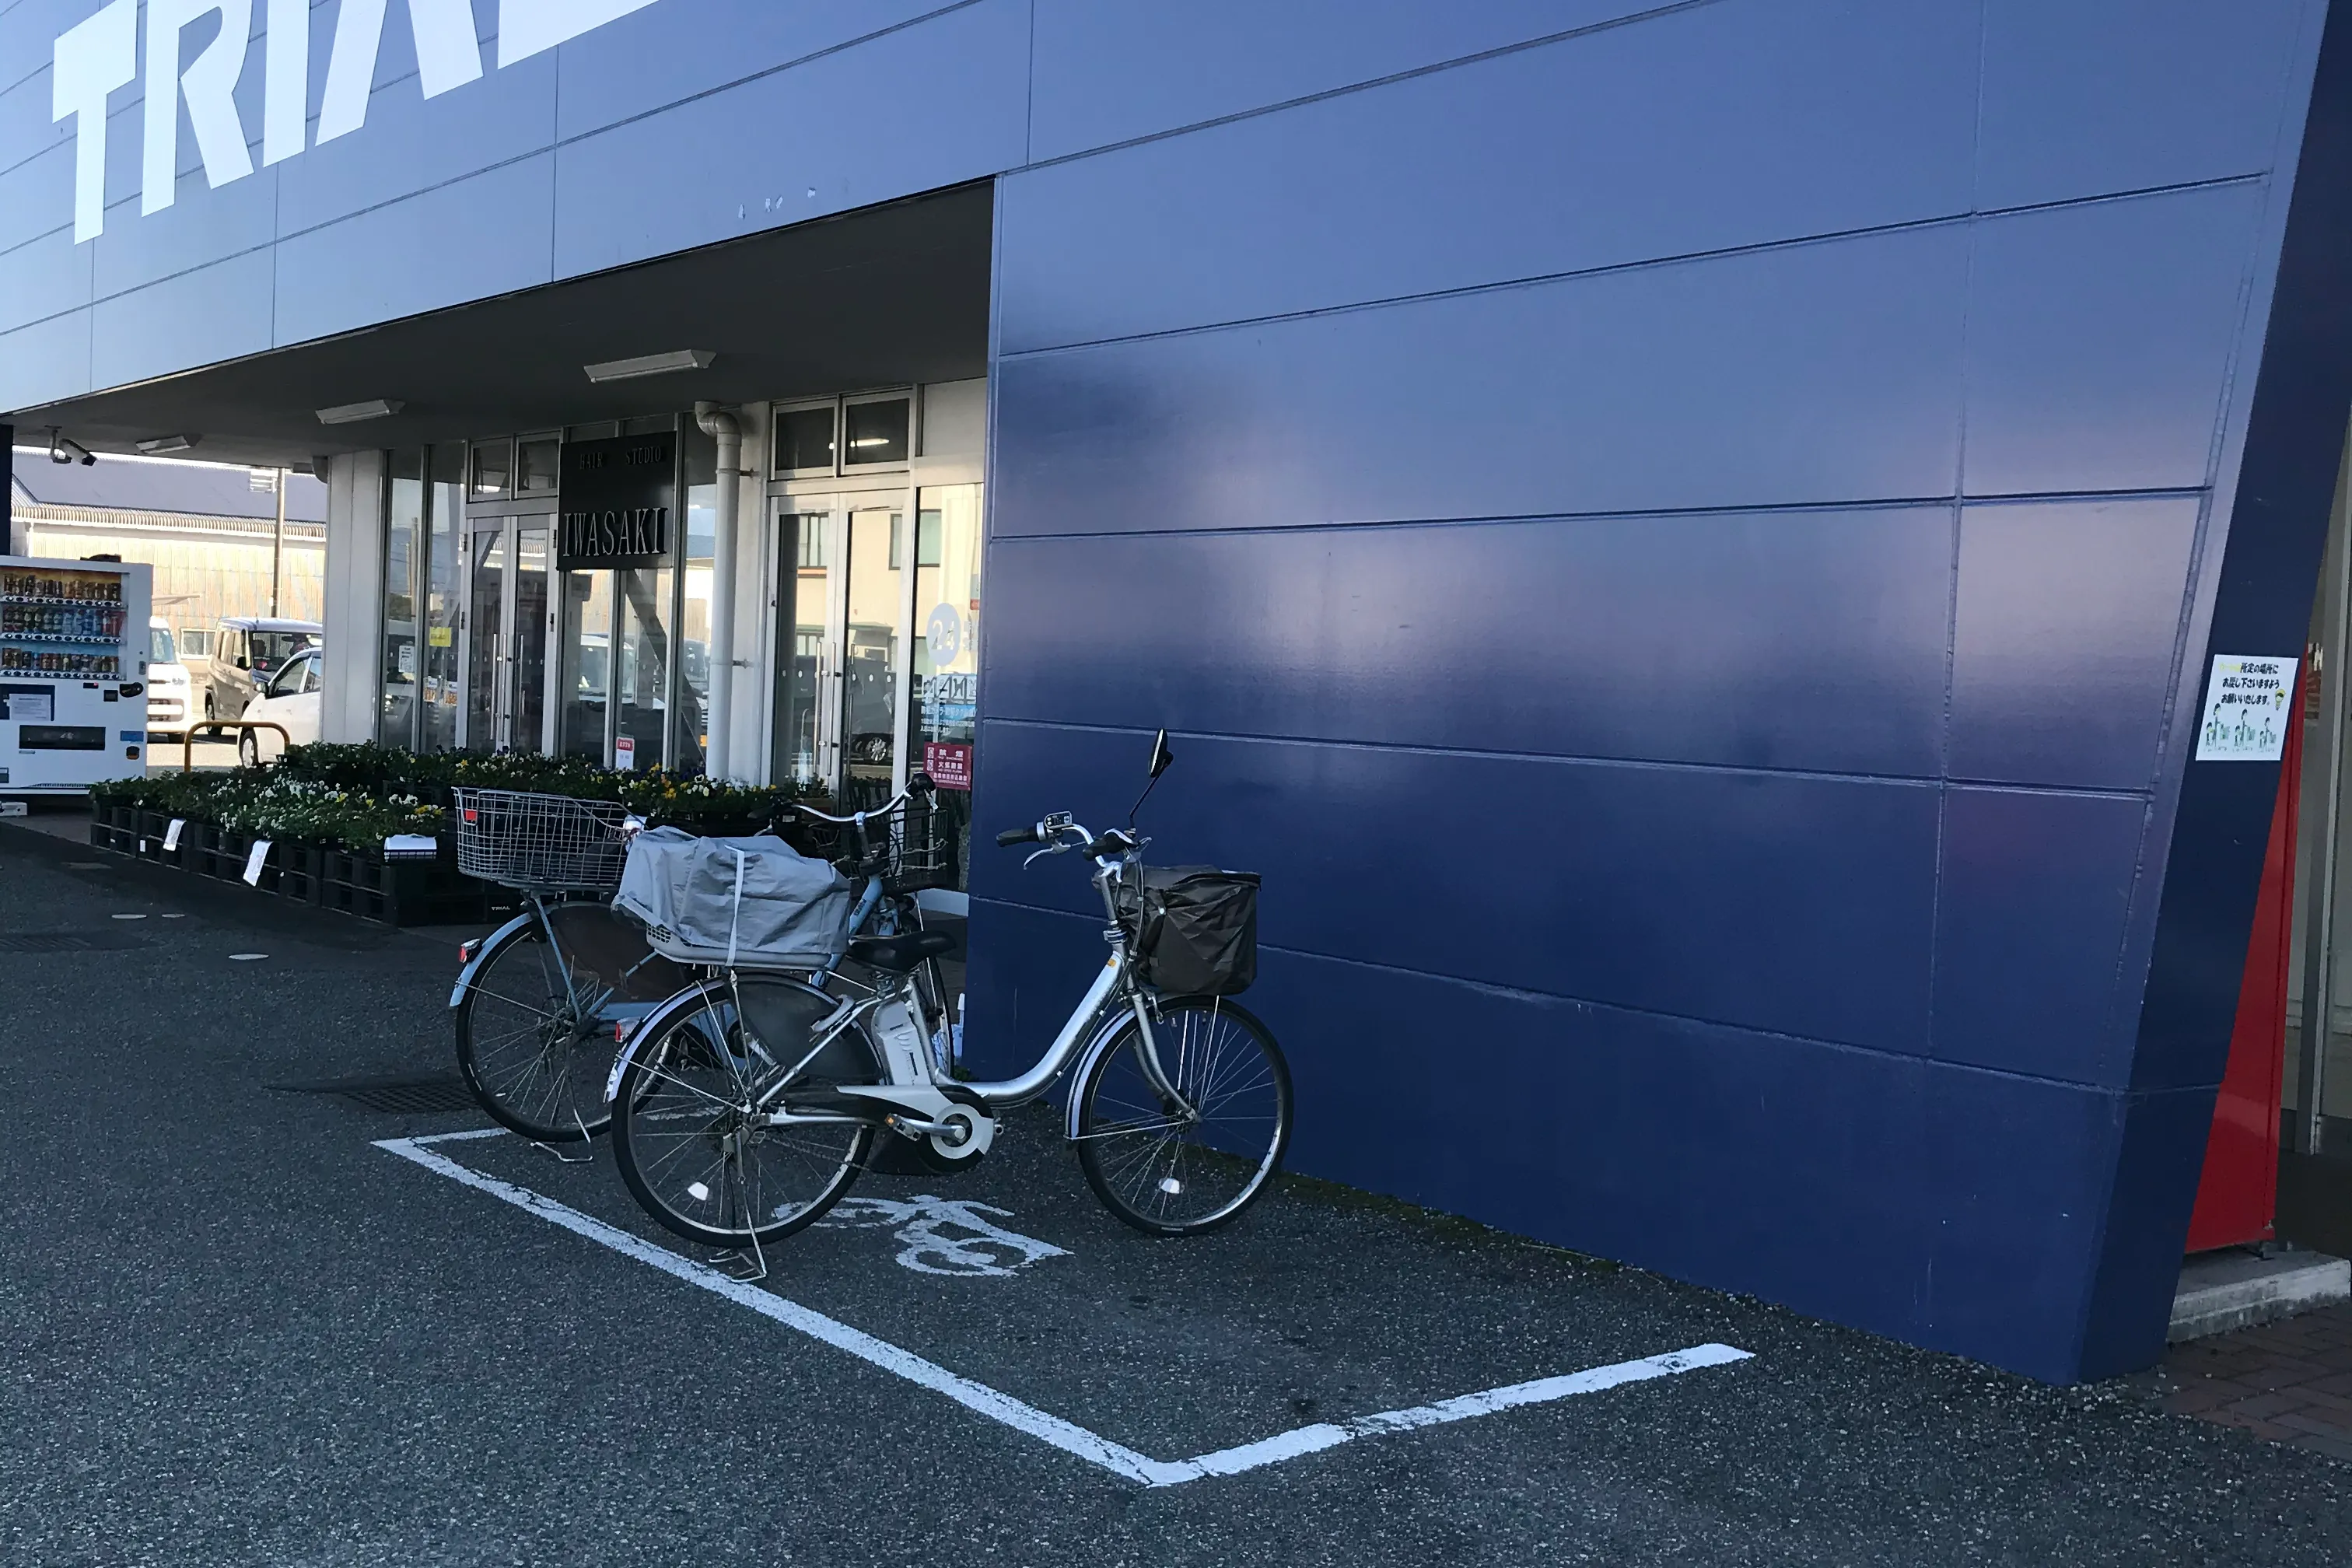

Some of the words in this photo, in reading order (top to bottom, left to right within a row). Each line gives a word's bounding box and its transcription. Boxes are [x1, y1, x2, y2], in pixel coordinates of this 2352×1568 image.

[52, 0, 661, 246] TRIA
[625, 446, 661, 465] STUDIO
[562, 508, 661, 558] IWASAKI
